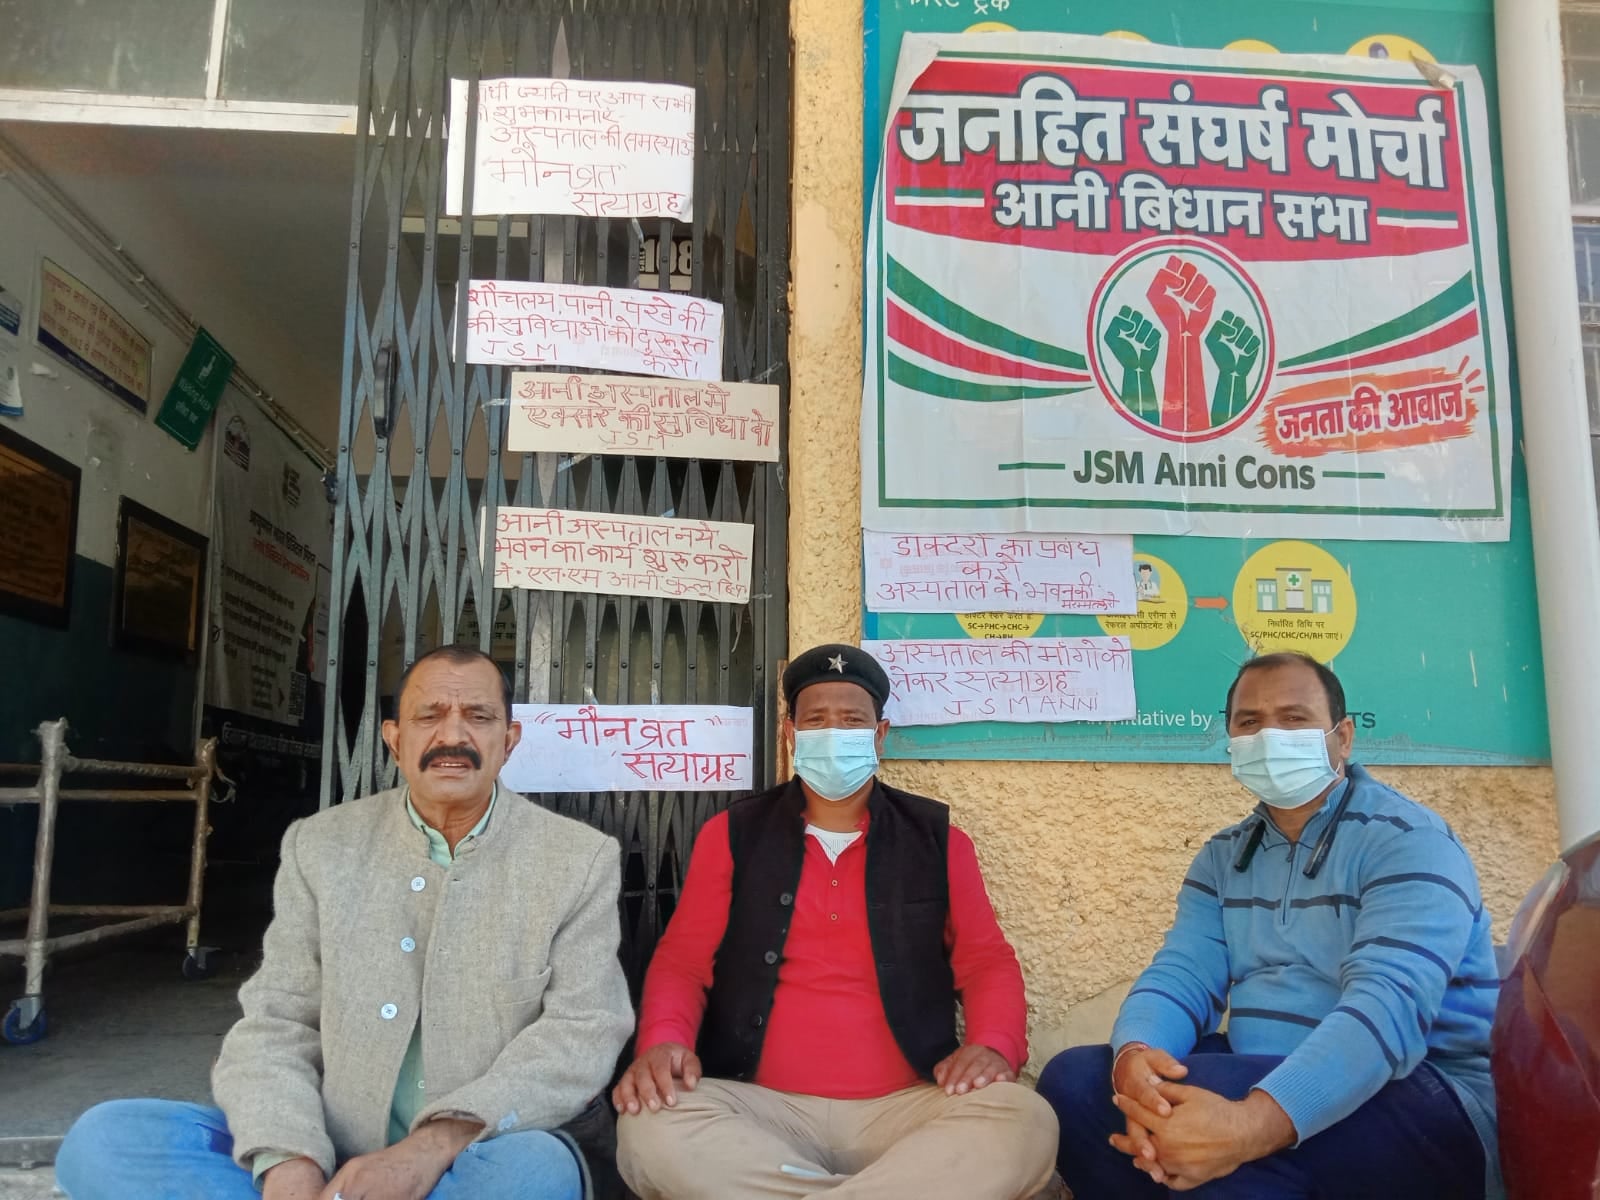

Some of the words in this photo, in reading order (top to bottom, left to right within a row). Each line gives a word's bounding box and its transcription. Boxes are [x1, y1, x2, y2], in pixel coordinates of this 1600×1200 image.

[577, 90, 602, 108] पर
[602, 92, 646, 110] आप
[651, 94, 693, 113] सभी
[491, 126, 603, 150] अस्पताल
[601, 124, 621, 151] की
[898, 74, 1127, 167] जनहित
[1138, 82, 1290, 173] संघर्ष
[1301, 92, 1446, 188] मोर्चा
[571, 191, 687, 217] सत्याग्रह
[995, 170, 1110, 229] आनी
[1119, 173, 1263, 236] बिधान
[1273, 193, 1369, 242] सभा
[559, 291, 613, 319] पानी
[679, 302, 714, 332] की
[468, 311, 496, 335] की
[609, 316, 637, 348] को
[518, 376, 589, 400] आनी
[619, 404, 649, 431] की
[750, 408, 774, 447] दो
[1278, 405, 1343, 440] जनता
[1346, 388, 1382, 432] की
[1386, 384, 1466, 426] आवाज
[1074, 449, 1145, 484] JSM
[1154, 453, 1227, 488] Anni
[1235, 456, 1316, 490] Cons
[496, 510, 564, 536] आनी
[567, 518, 675, 546] अस्पताल
[675, 521, 719, 550] नये
[494, 536, 549, 561] भवन
[552, 541, 584, 563] का
[587, 542, 639, 569] कार्य
[693, 544, 748, 581] करो
[1001, 539, 1032, 557] का
[956, 552, 1023, 582] करो
[877, 580, 989, 602] अस्पताल
[1023, 582, 1075, 603] भवन
[1075, 571, 1094, 599] की
[877, 643, 998, 666] अस्पताल
[1000, 640, 1032, 665] की
[1101, 637, 1132, 673] को
[954, 670, 1080, 697] सत्याग्रह
[1191, 709, 1212, 731] by
[622, 753, 746, 783] सत्याग्रह
